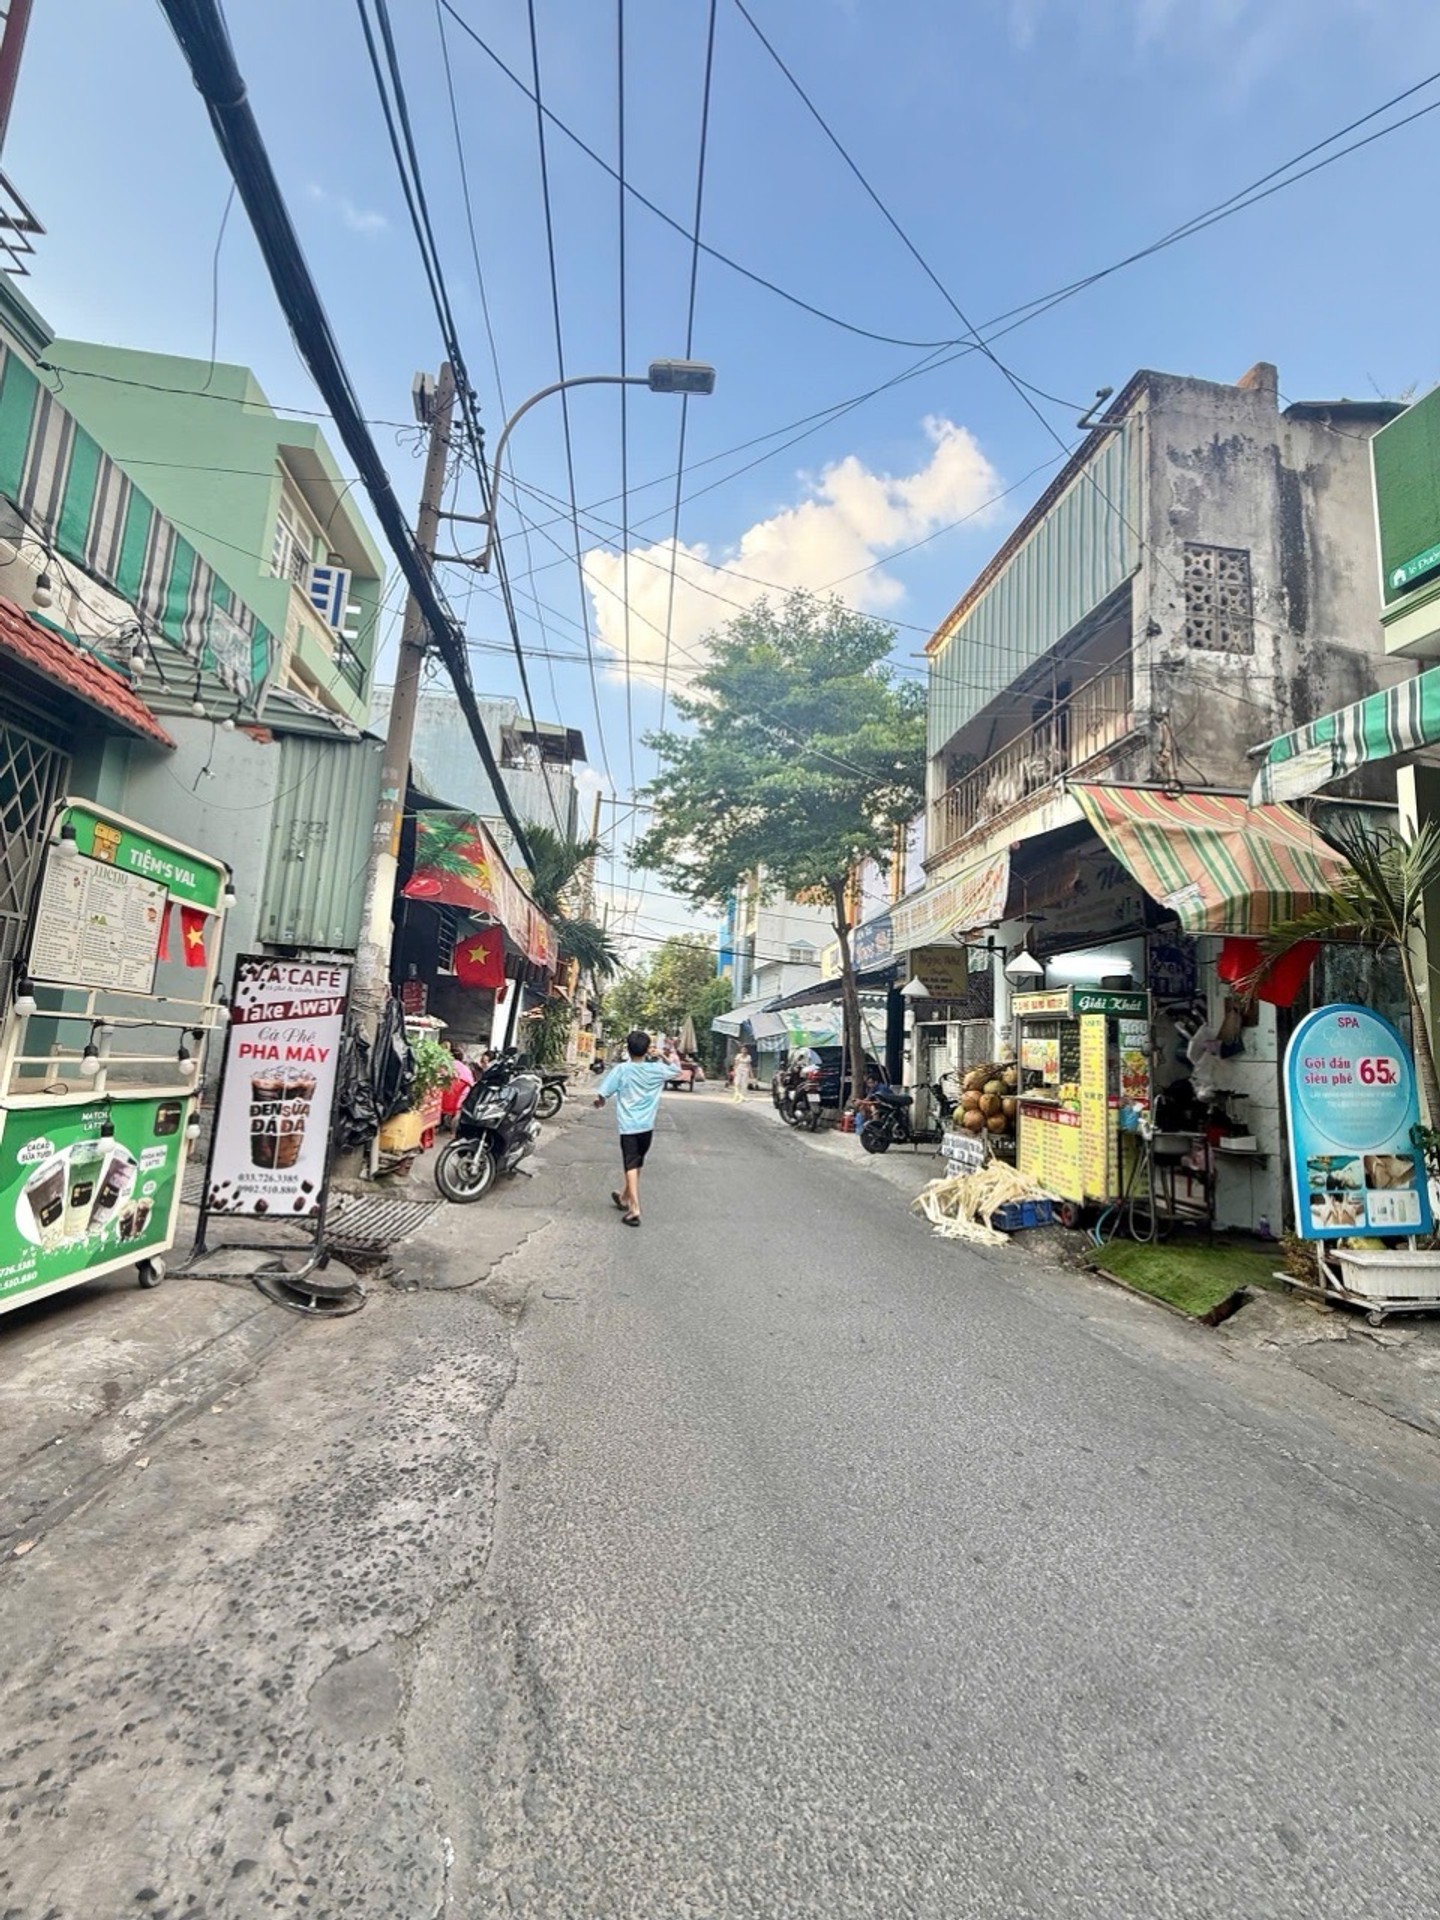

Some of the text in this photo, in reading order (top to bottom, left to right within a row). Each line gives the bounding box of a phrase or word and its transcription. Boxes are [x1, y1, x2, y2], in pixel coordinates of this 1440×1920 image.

[173, 867, 197, 888] VAL
[288, 967, 341, 988] CAFÉ
[243, 998, 341, 1022] Take Away
[1337, 1017, 1360, 1028] SPA
[238, 1043, 330, 1062] PHA MÁY
[251, 1117, 277, 1133] ĐÁ
